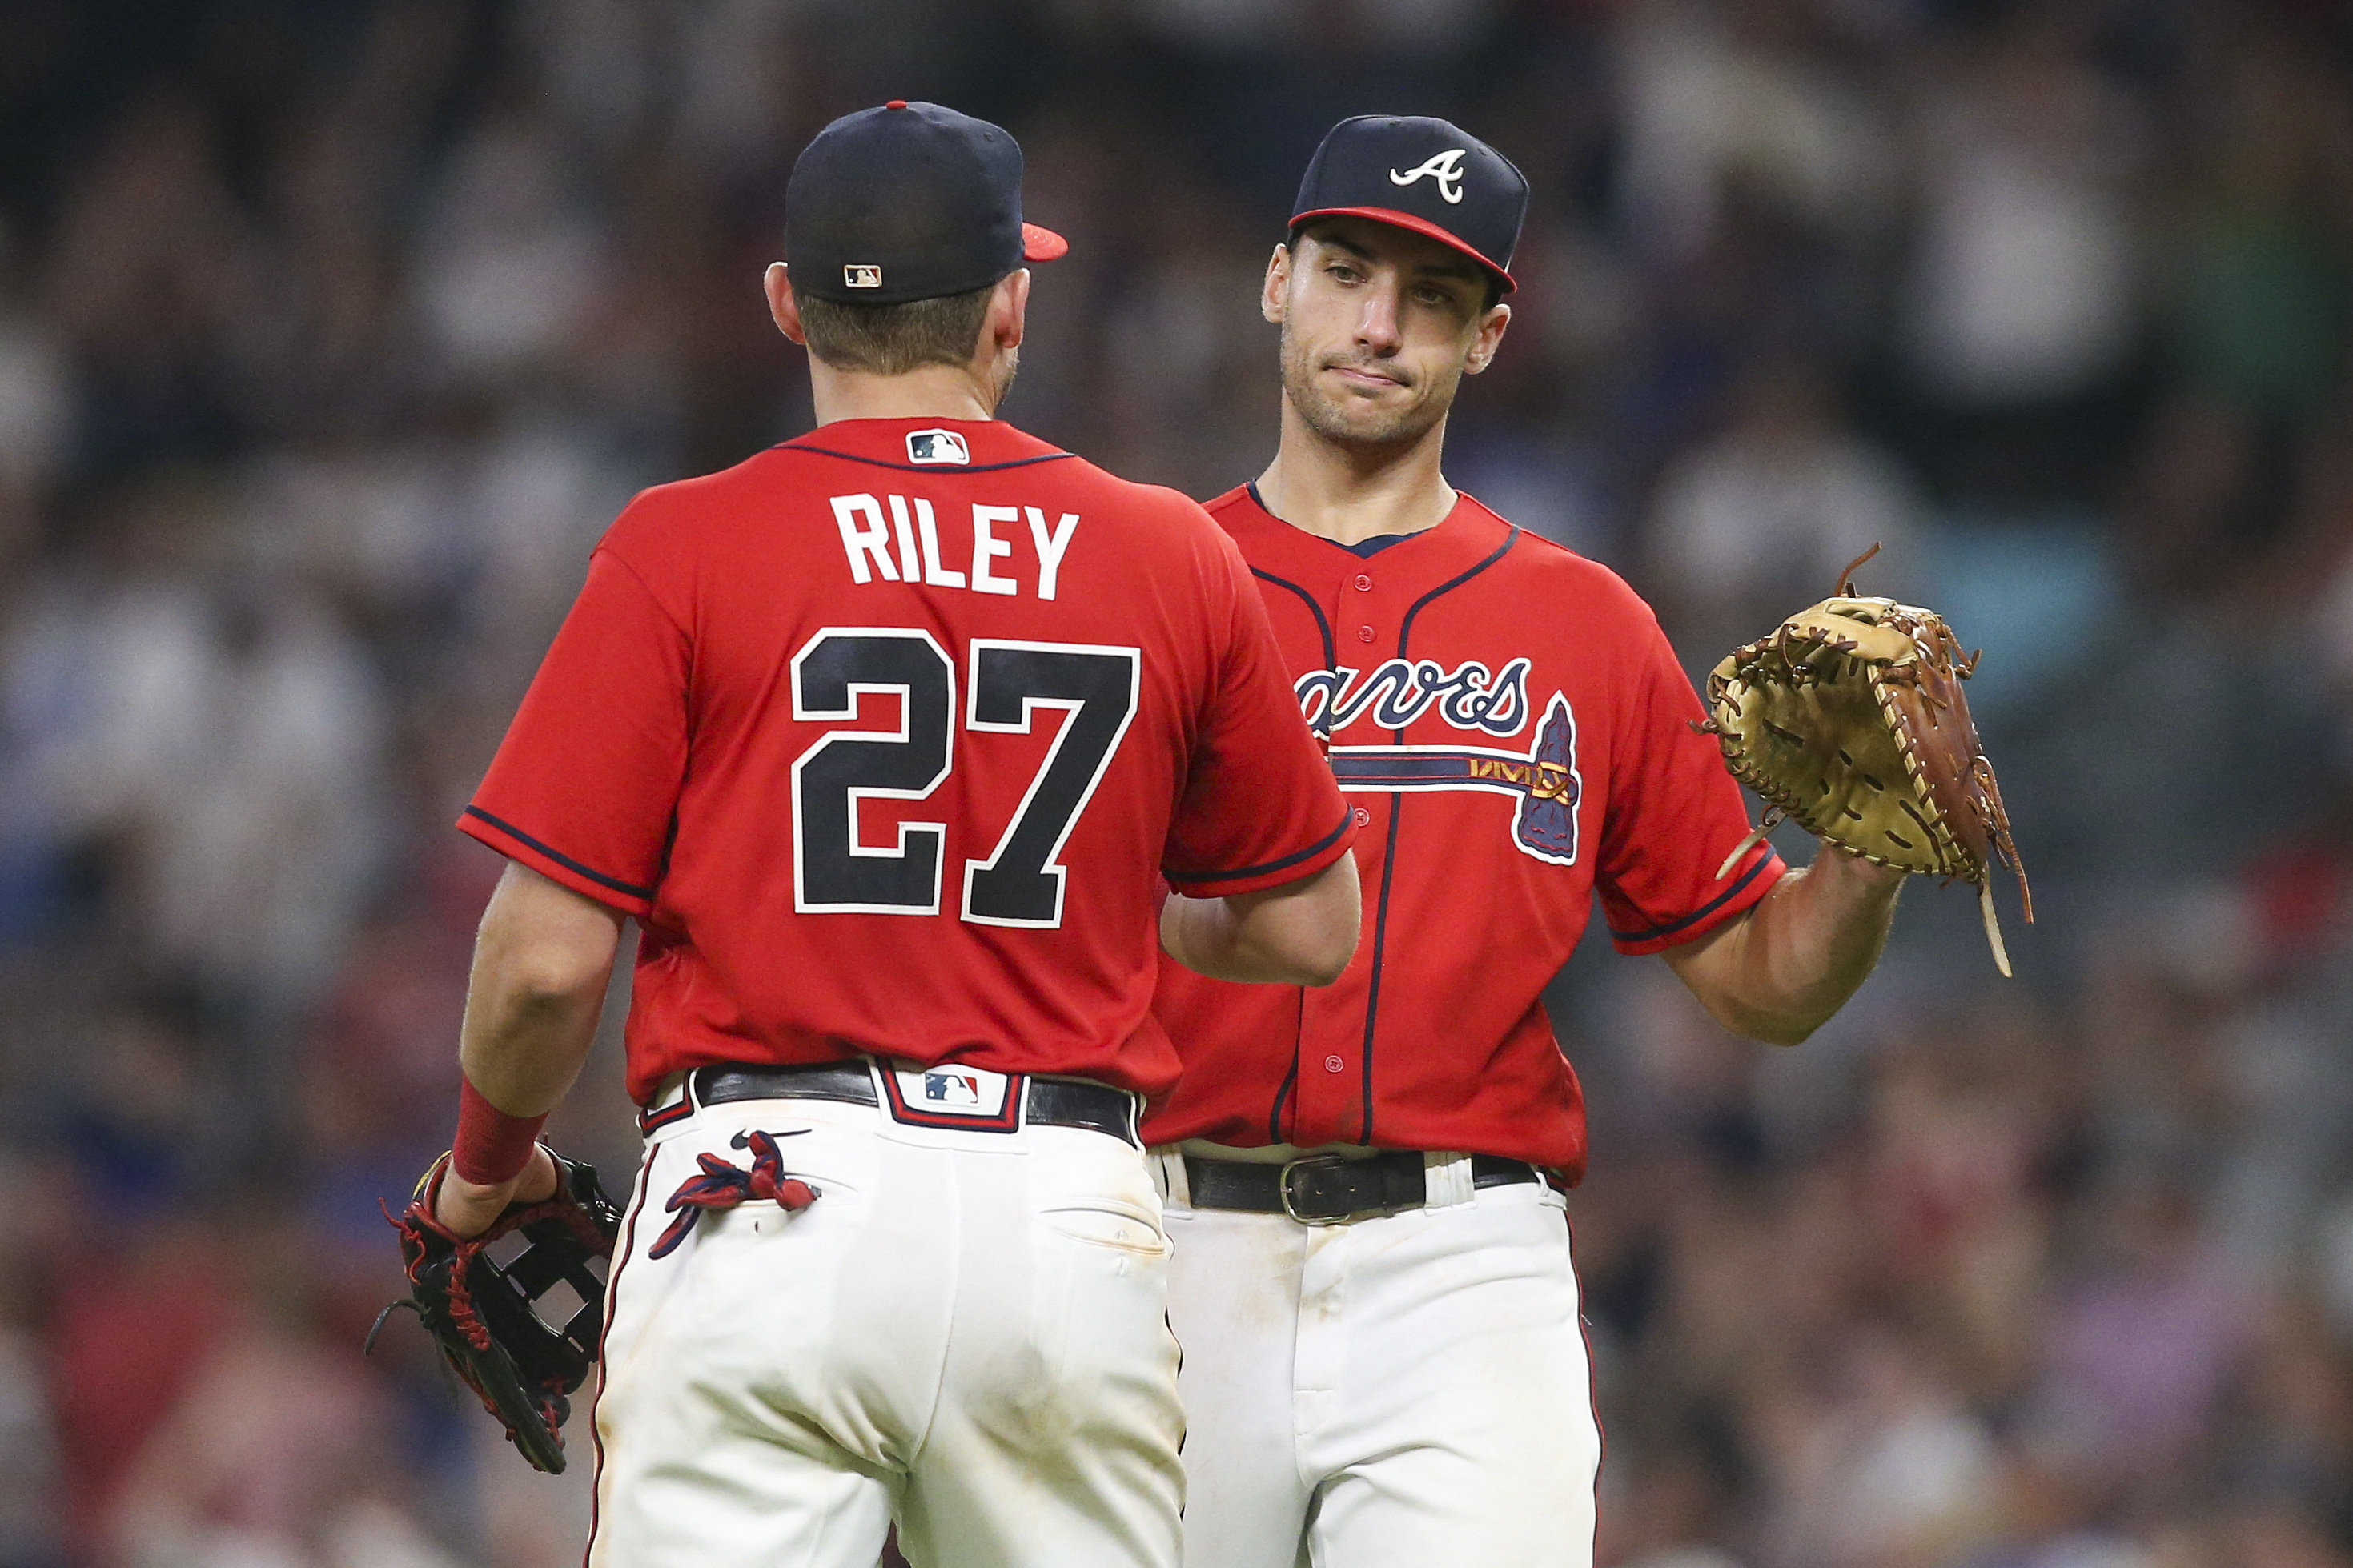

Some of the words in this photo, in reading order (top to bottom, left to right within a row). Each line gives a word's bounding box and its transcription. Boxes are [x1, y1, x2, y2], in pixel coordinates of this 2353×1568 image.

[1389, 149, 1467, 204] A
[829, 493, 1080, 601] RILEY
[1294, 657, 1532, 740] aves
[790, 626, 1142, 929] 27
